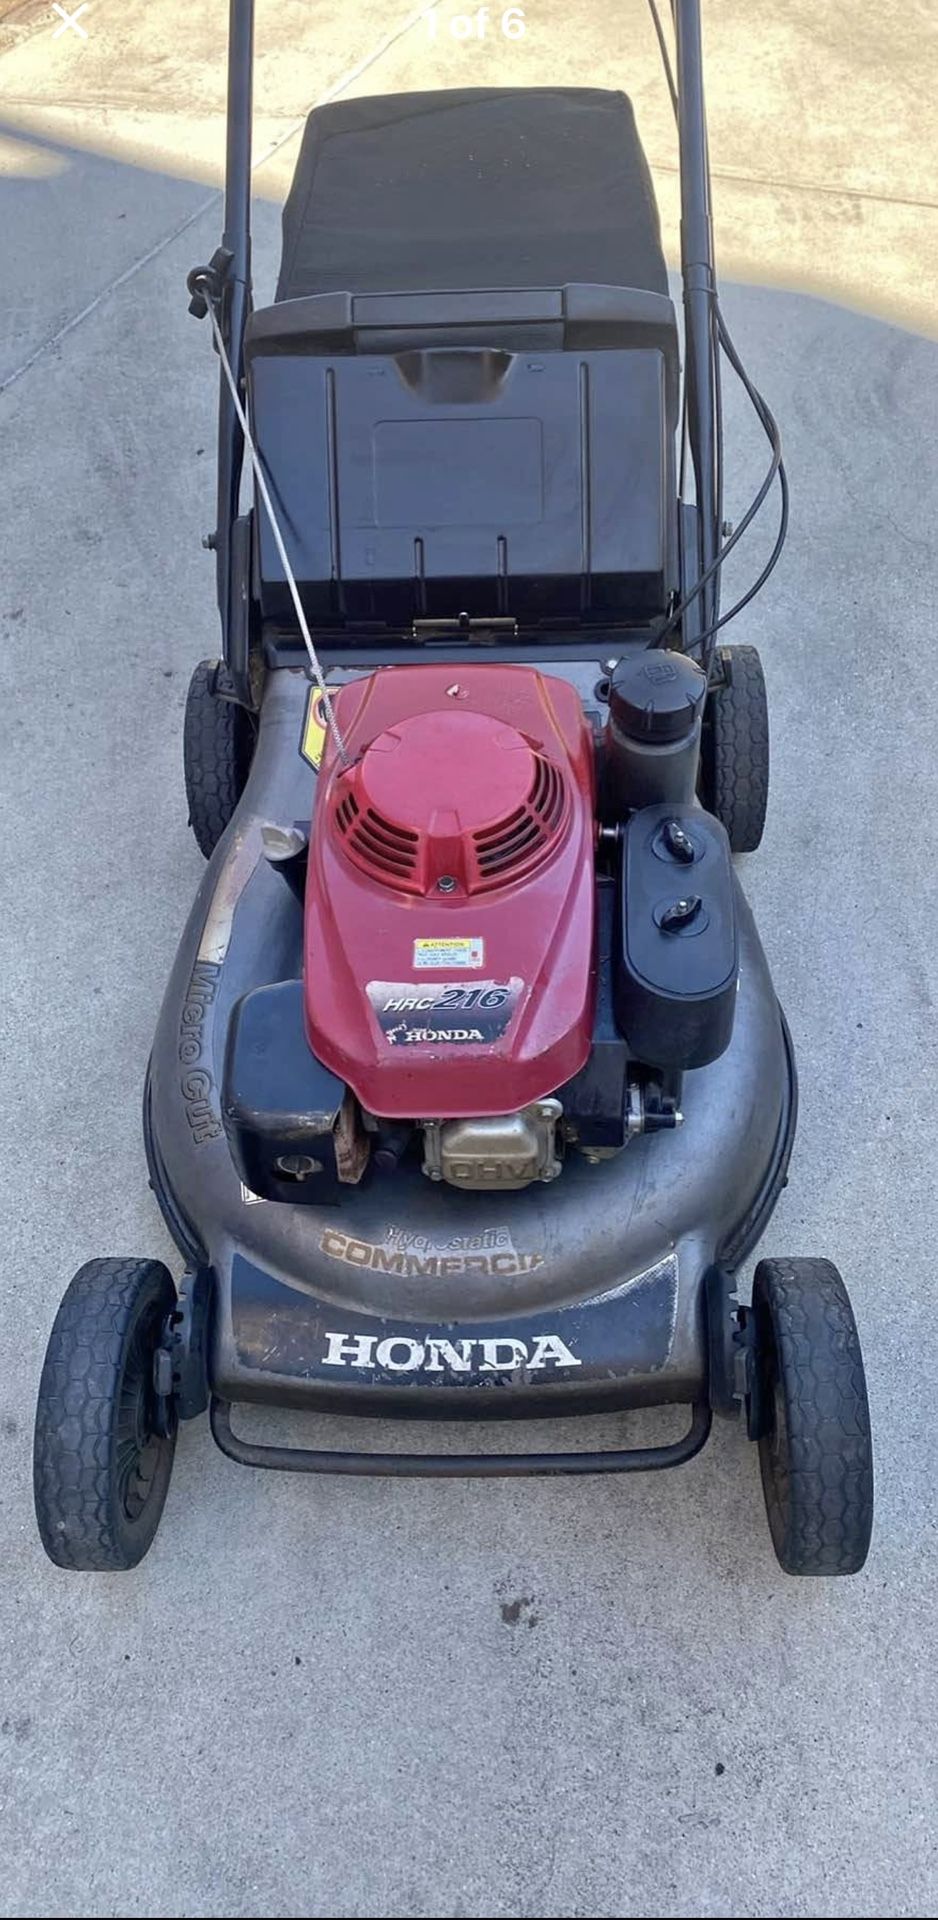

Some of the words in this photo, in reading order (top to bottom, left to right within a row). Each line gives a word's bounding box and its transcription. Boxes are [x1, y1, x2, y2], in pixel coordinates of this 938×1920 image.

[179, 963, 220, 1064] Micro
[405, 1029, 484, 1042] HONDA
[181, 1069, 223, 1144] Cut
[449, 1160, 530, 1179] OHV
[321, 1332, 582, 1371] HONDA
